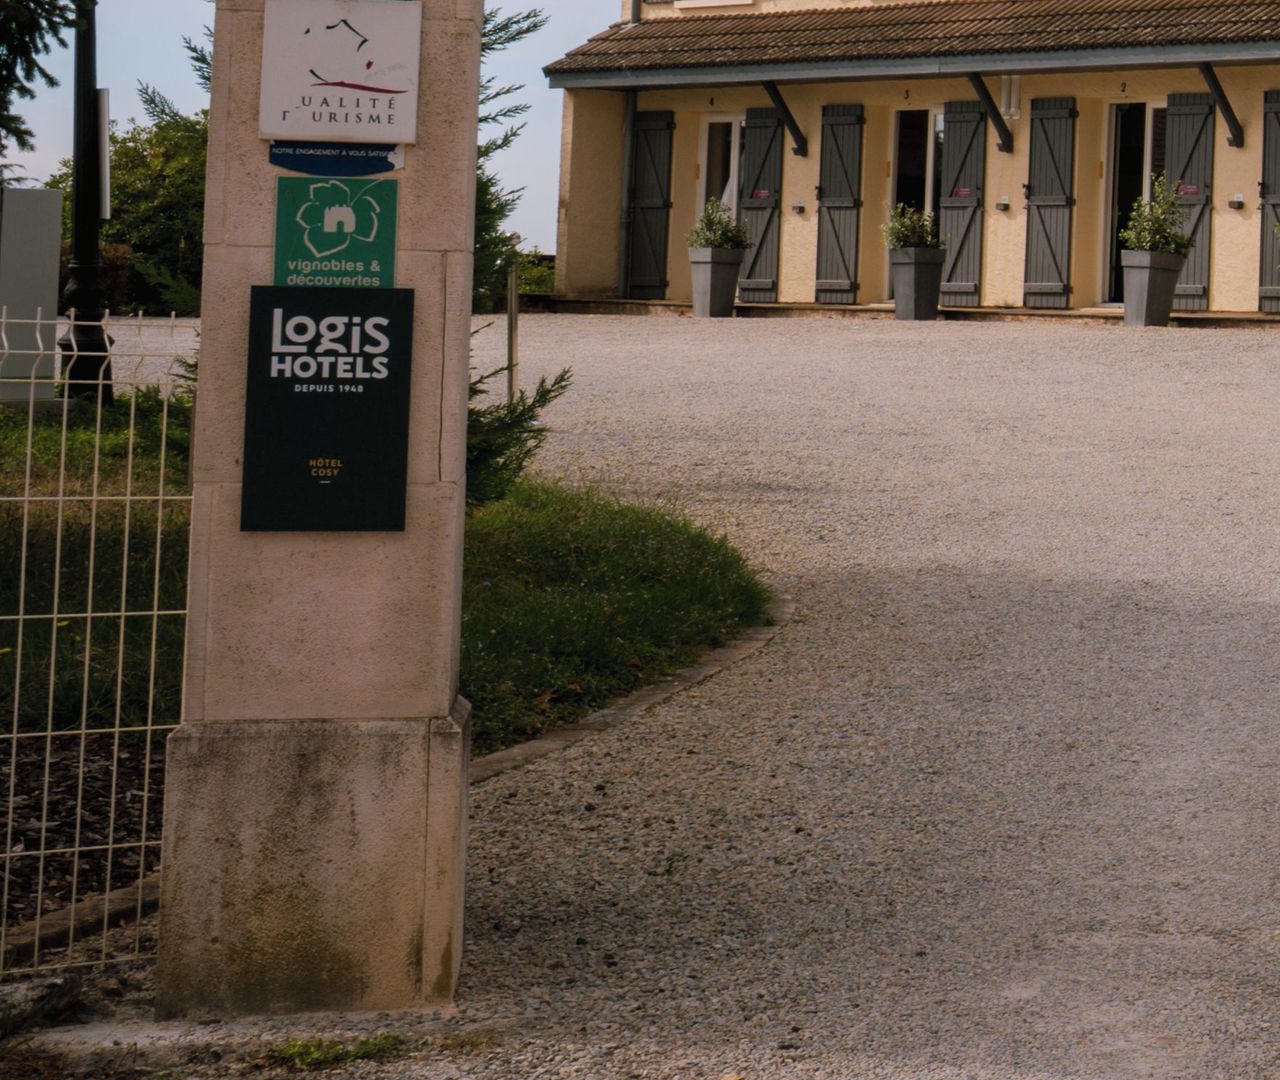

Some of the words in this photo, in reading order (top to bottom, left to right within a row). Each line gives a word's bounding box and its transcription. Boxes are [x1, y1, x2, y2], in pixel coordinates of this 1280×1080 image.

[294, 95, 395, 110] UALITÉ
[281, 110, 395, 125] TURISME
[295, 148, 340, 156] ENGAGEMENT
[288, 259, 364, 274] vignobles
[369, 259, 380, 272] &
[287, 274, 381, 287] découvertes
[270, 355, 389, 379] HOTELS
[294, 384, 335, 393] DEPUIS
[339, 384, 364, 393] 1948
[309, 457, 343, 467] HÔTEL
[311, 468, 340, 477] COSY
